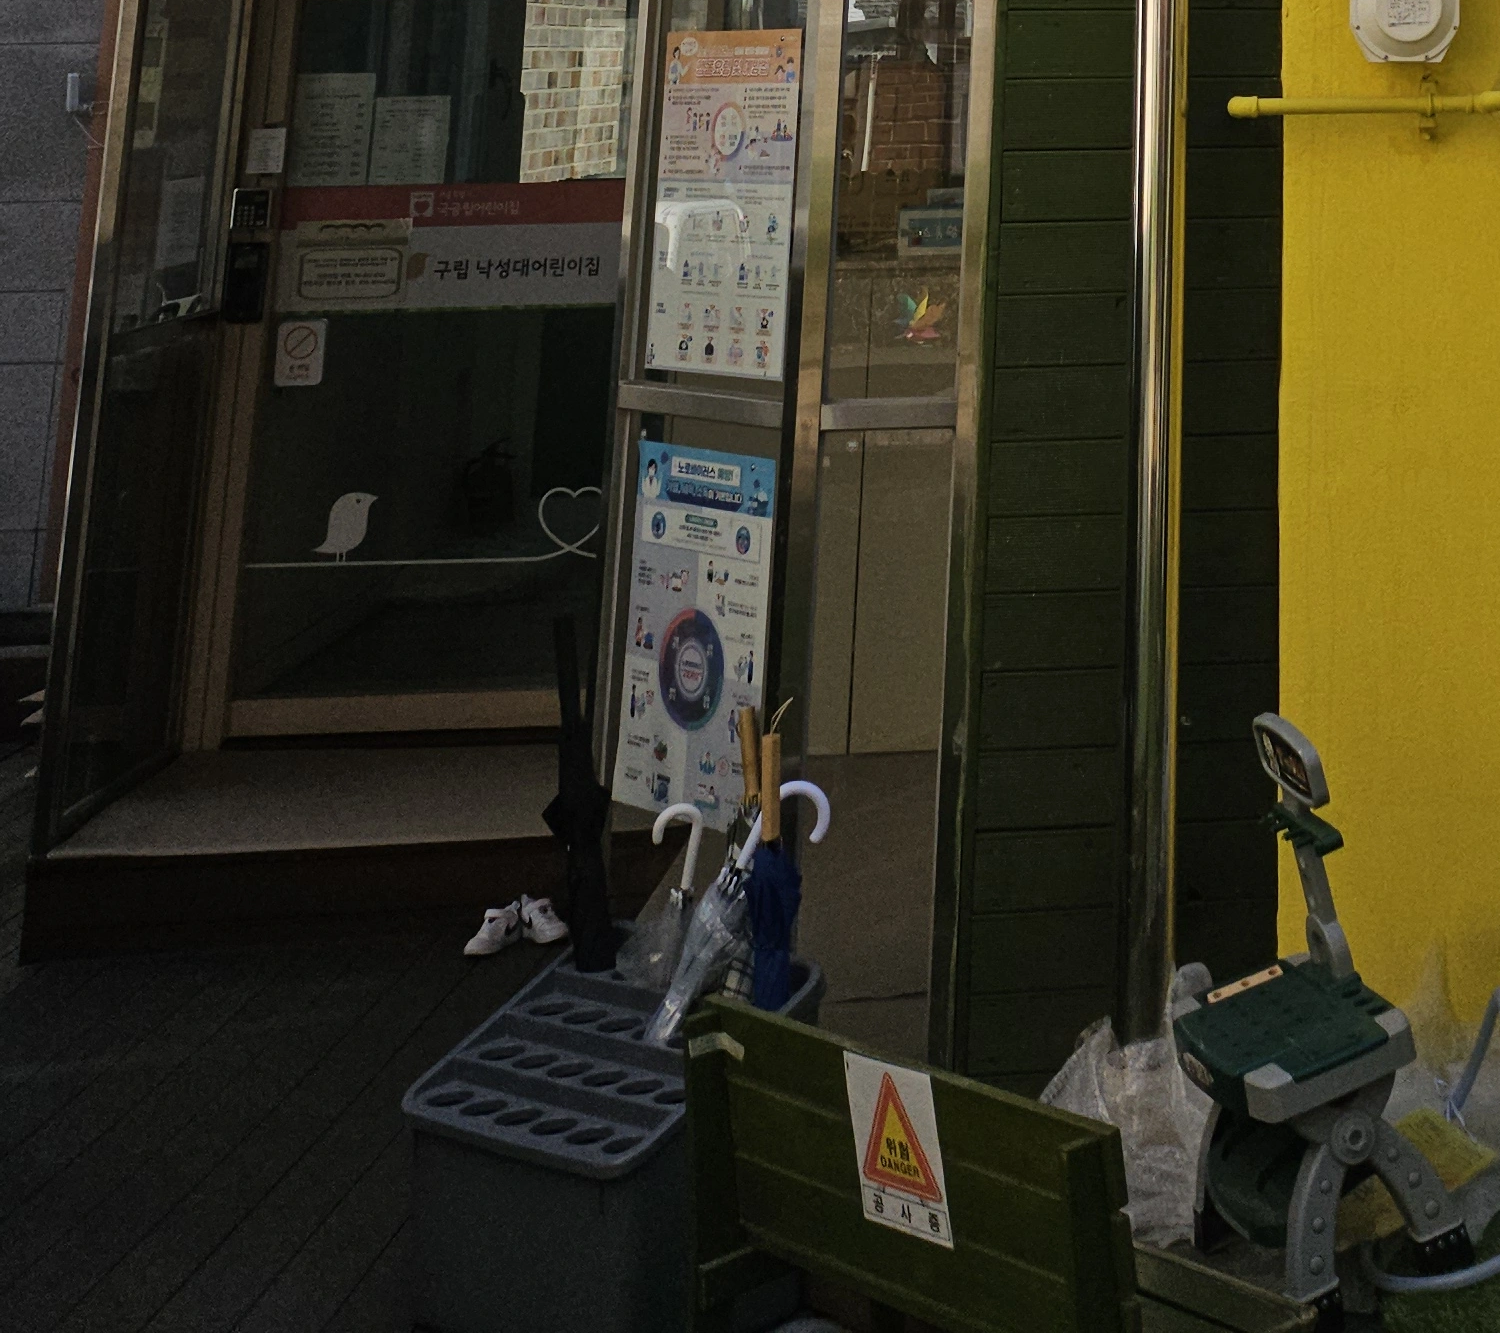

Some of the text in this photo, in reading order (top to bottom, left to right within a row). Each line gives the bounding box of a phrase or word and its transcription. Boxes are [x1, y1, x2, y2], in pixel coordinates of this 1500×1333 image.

[437, 200, 520, 218] 국공립어린이집
[433, 256, 600, 280] 구립 낙성대어린이집
[886, 1136, 910, 1162] 위험
[880, 1153, 921, 1178] DANGER
